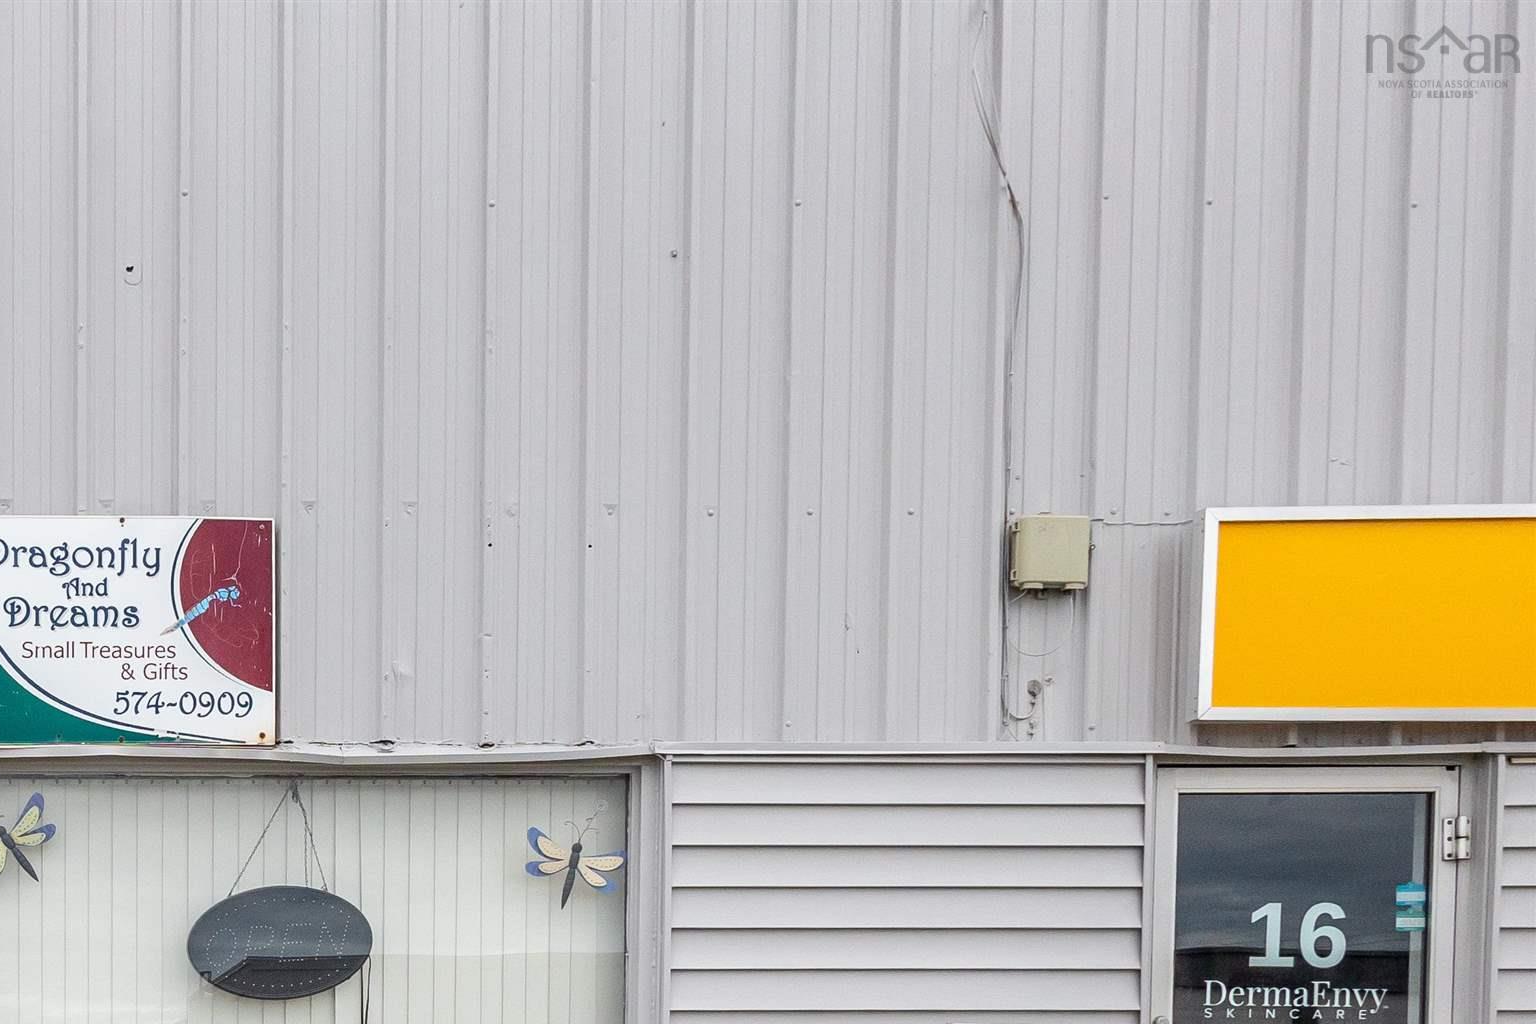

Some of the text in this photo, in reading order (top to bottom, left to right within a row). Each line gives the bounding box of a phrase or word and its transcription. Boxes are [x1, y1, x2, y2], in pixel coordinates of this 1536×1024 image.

[62, 577, 108, 599] And
[3, 596, 140, 629] Dreams
[21, 641, 176, 659] Small Treasures
[120, 663, 188, 680] & Gifts
[113, 690, 253, 718] 574-0909
[206, 916, 352, 967] OPEN
[1248, 902, 1346, 969] 16
[1203, 979, 1388, 1014] DermaEnvy
[1204, 1007, 1367, 1020] SKINCARE
